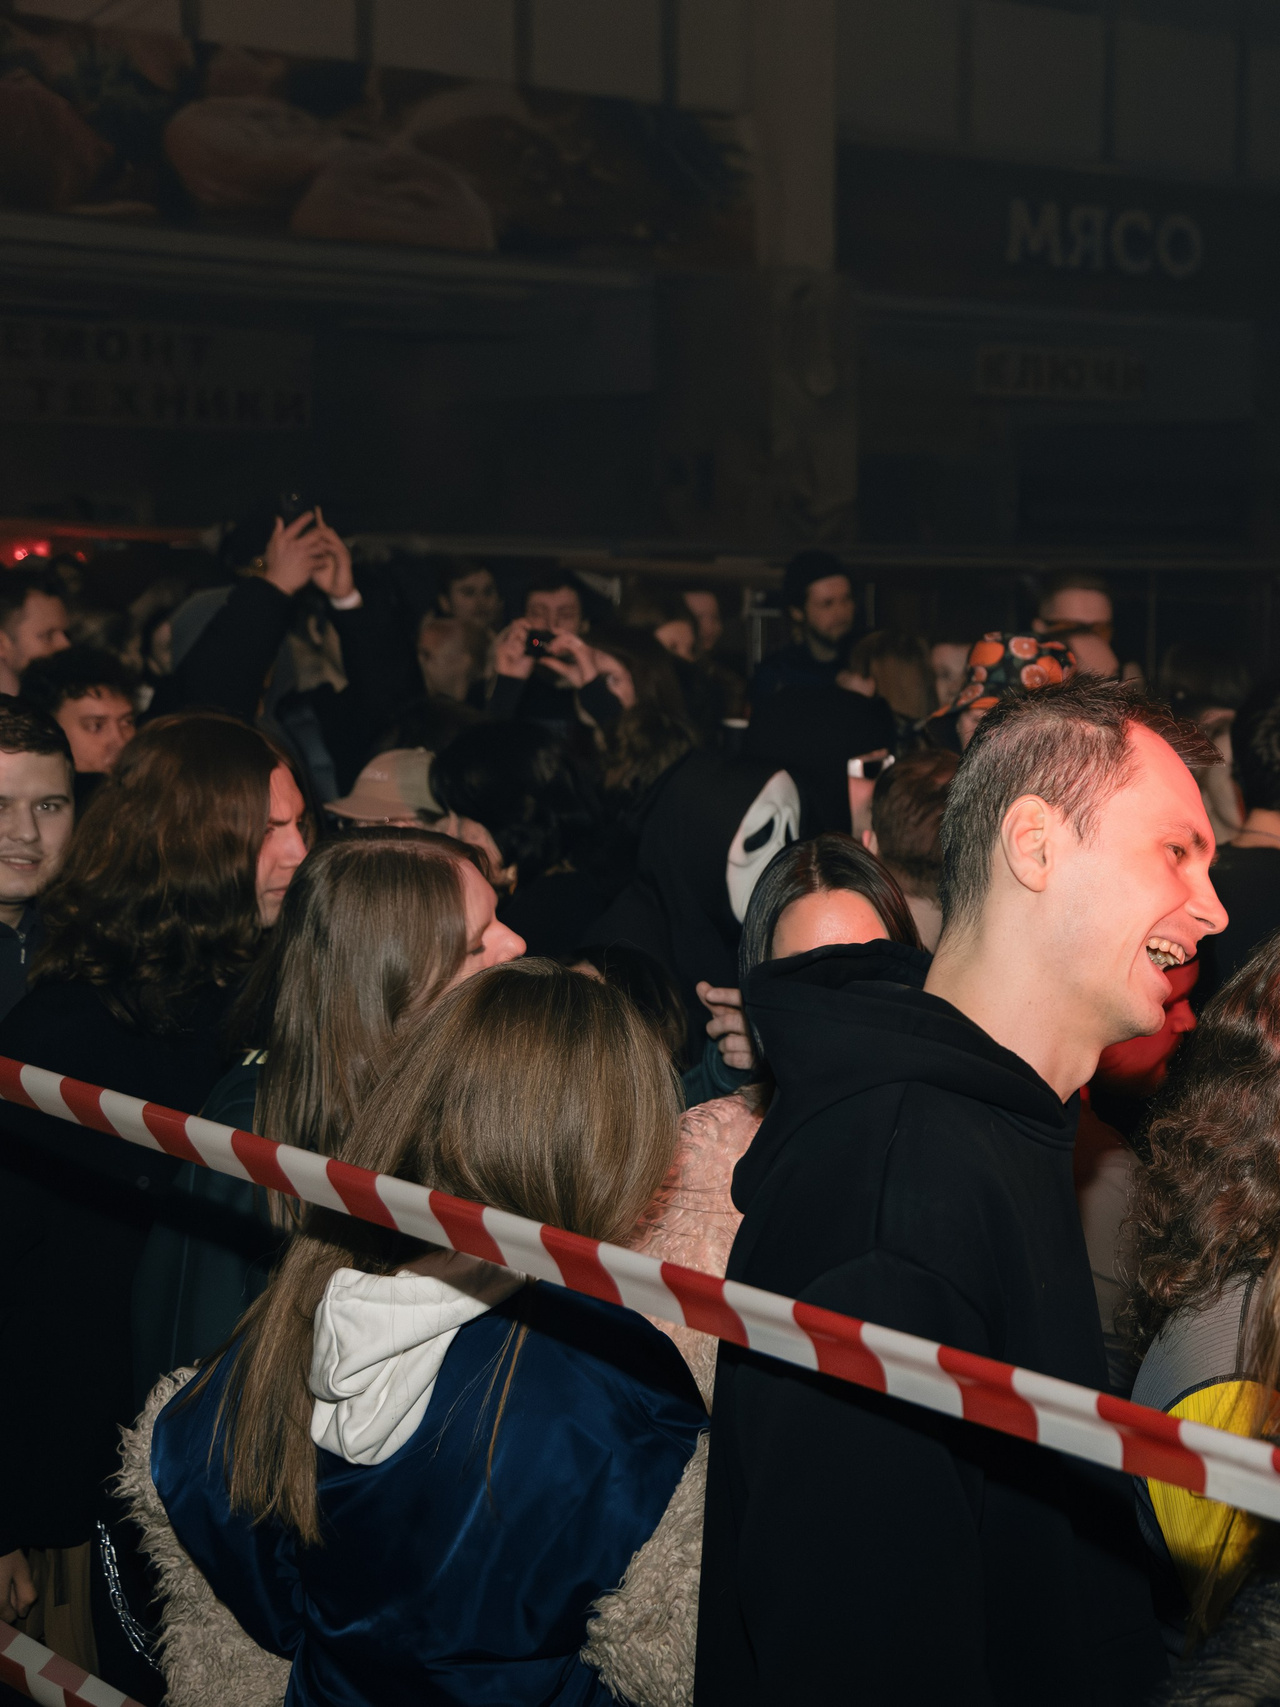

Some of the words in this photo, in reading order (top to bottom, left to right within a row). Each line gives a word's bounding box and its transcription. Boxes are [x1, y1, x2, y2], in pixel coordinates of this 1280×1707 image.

[1004, 196, 1205, 280] МЯСО
[2, 322, 212, 366] ЕМОНТ
[982, 352, 1150, 394] КЛЮЧИ
[27, 376, 308, 425] ТЕХНИКИ
